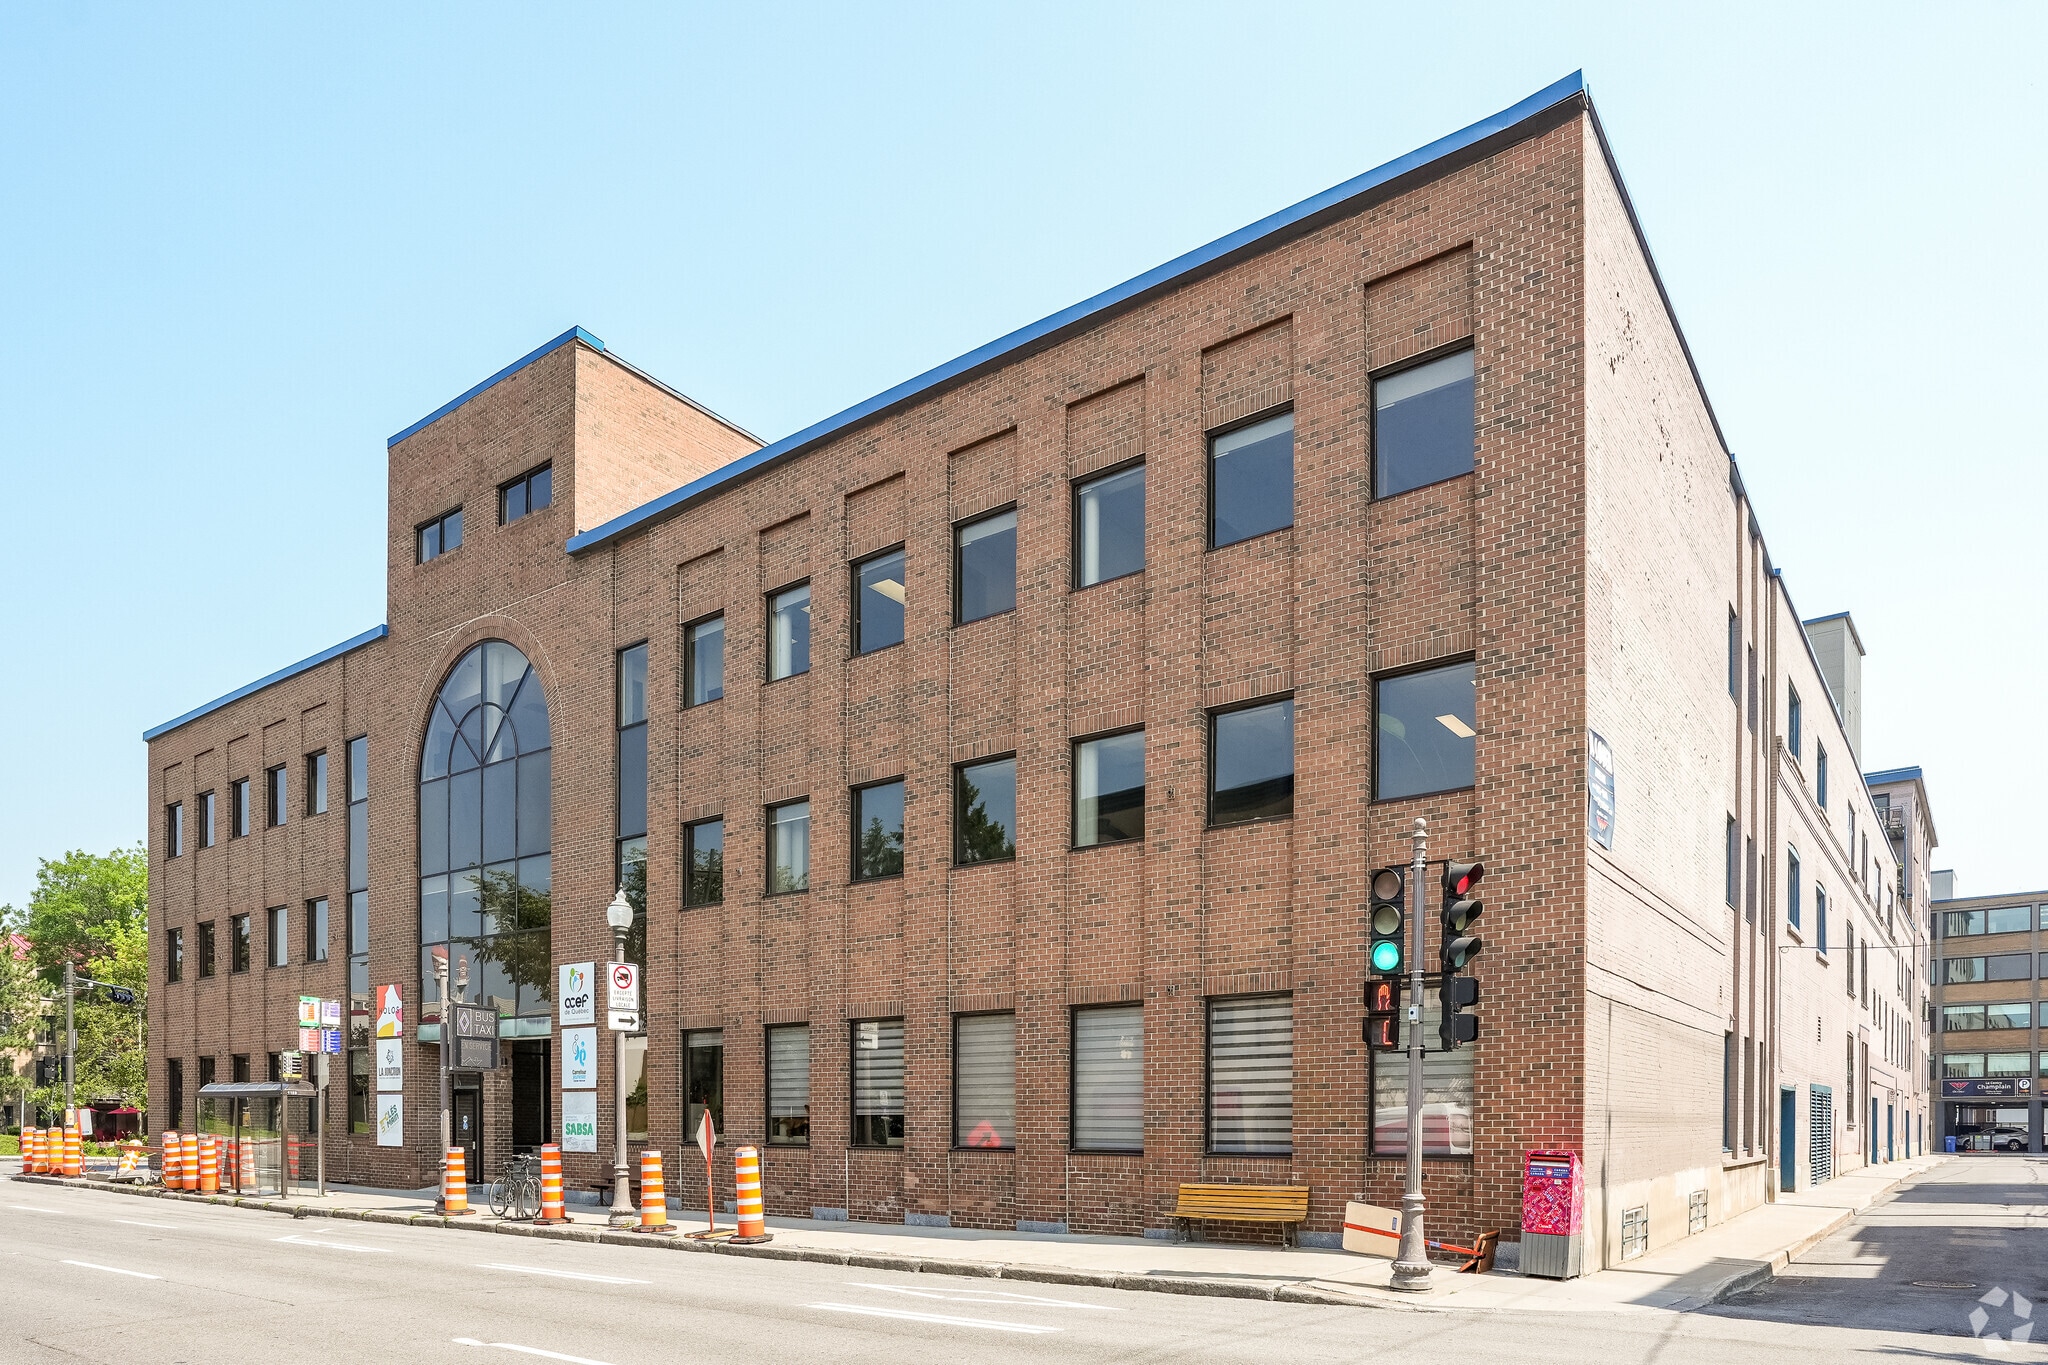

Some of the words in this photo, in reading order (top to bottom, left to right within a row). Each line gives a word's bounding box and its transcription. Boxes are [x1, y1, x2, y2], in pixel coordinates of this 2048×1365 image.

[379, 1006, 400, 1015] HOLOS
[475, 1011, 495, 1022] BUS
[474, 1023, 495, 1036] TAXI
[565, 1122, 594, 1136] SABSA
